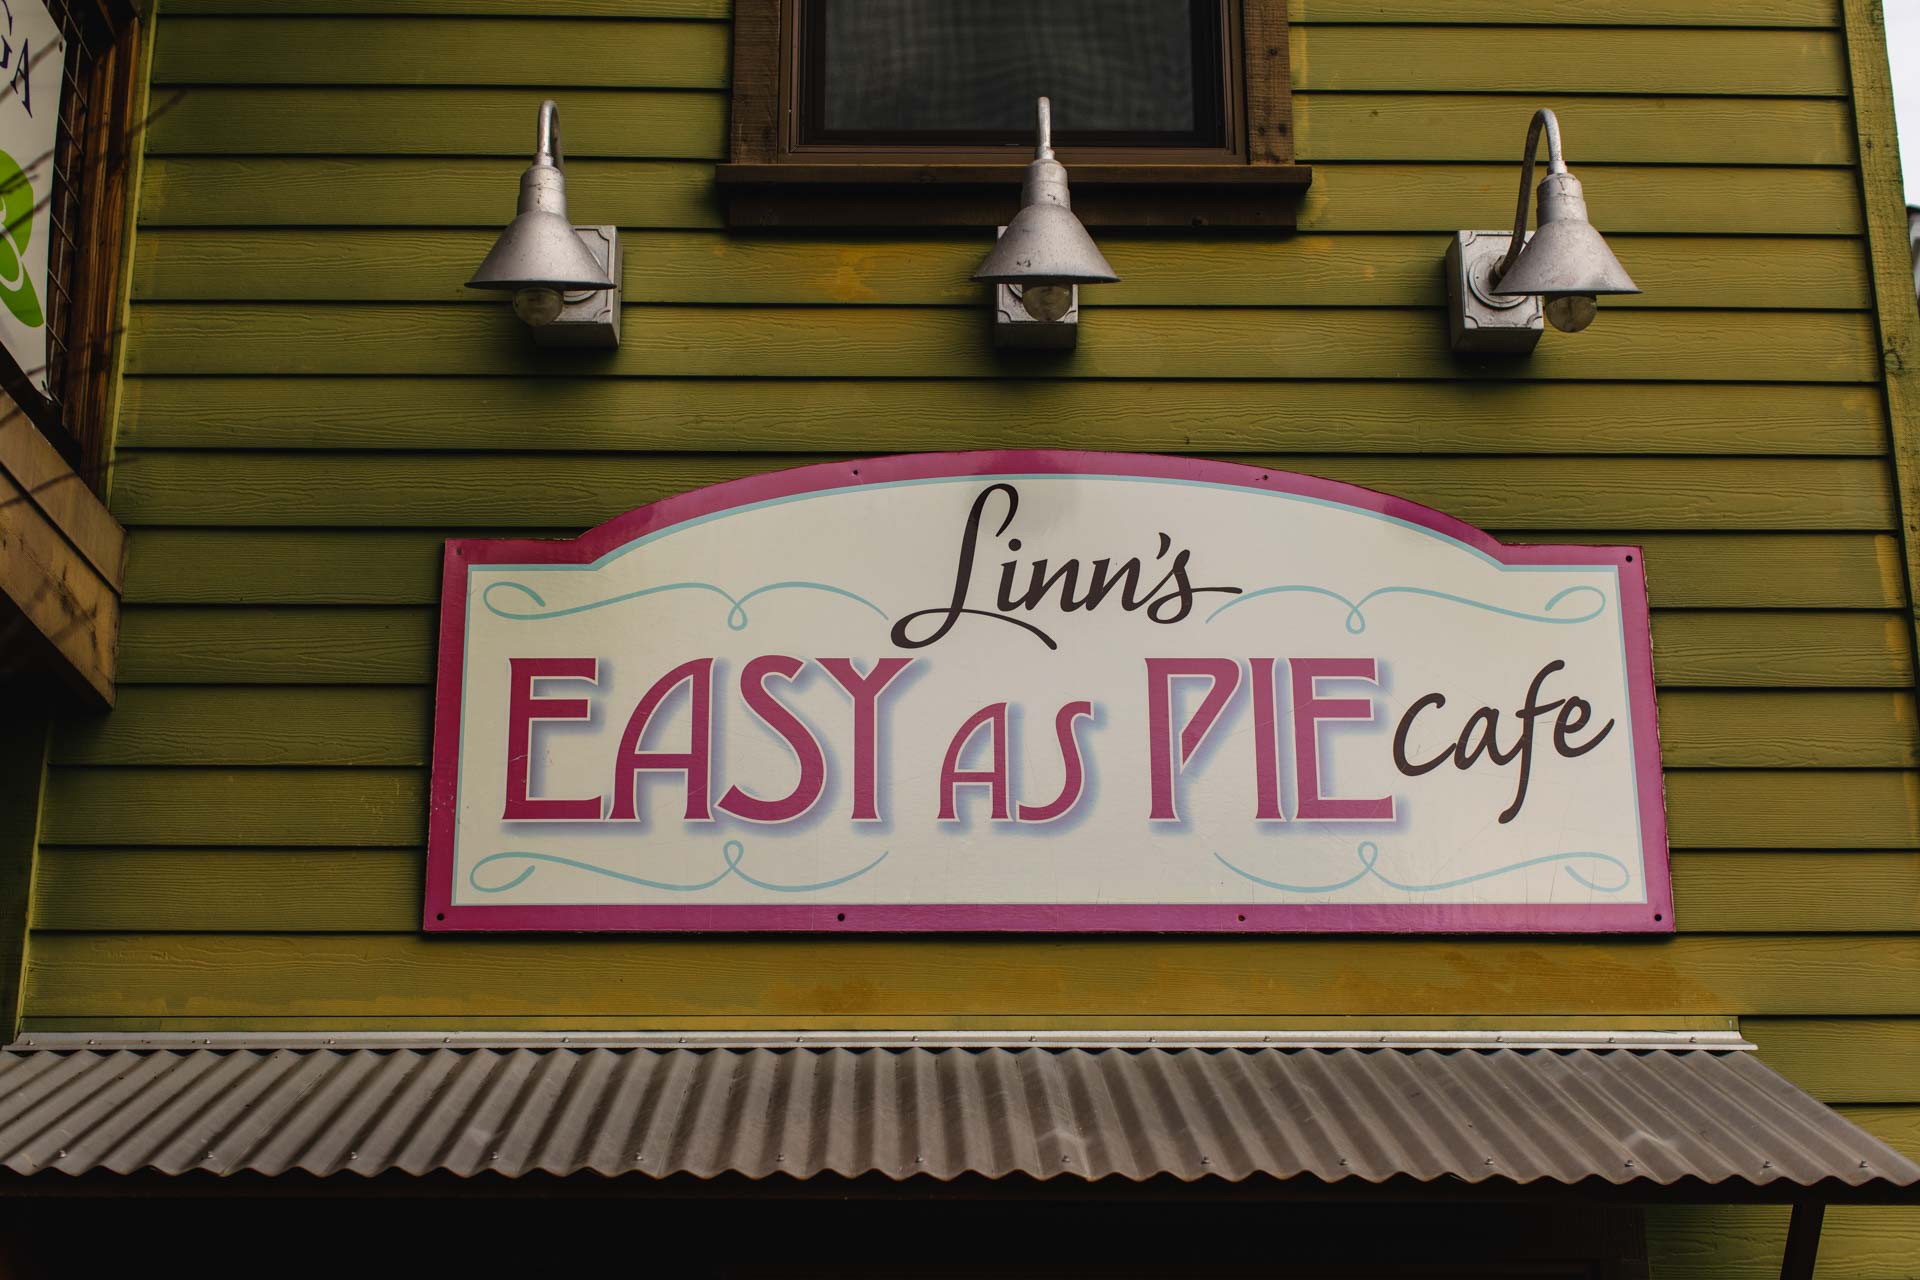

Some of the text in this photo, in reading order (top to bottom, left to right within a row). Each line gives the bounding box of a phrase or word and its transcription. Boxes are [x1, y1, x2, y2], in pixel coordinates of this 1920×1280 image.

[891, 484, 1242, 650] Linn's
[502, 655, 912, 821] EASY
[938, 701, 1092, 821] AS
[1145, 657, 1393, 820] PIE
